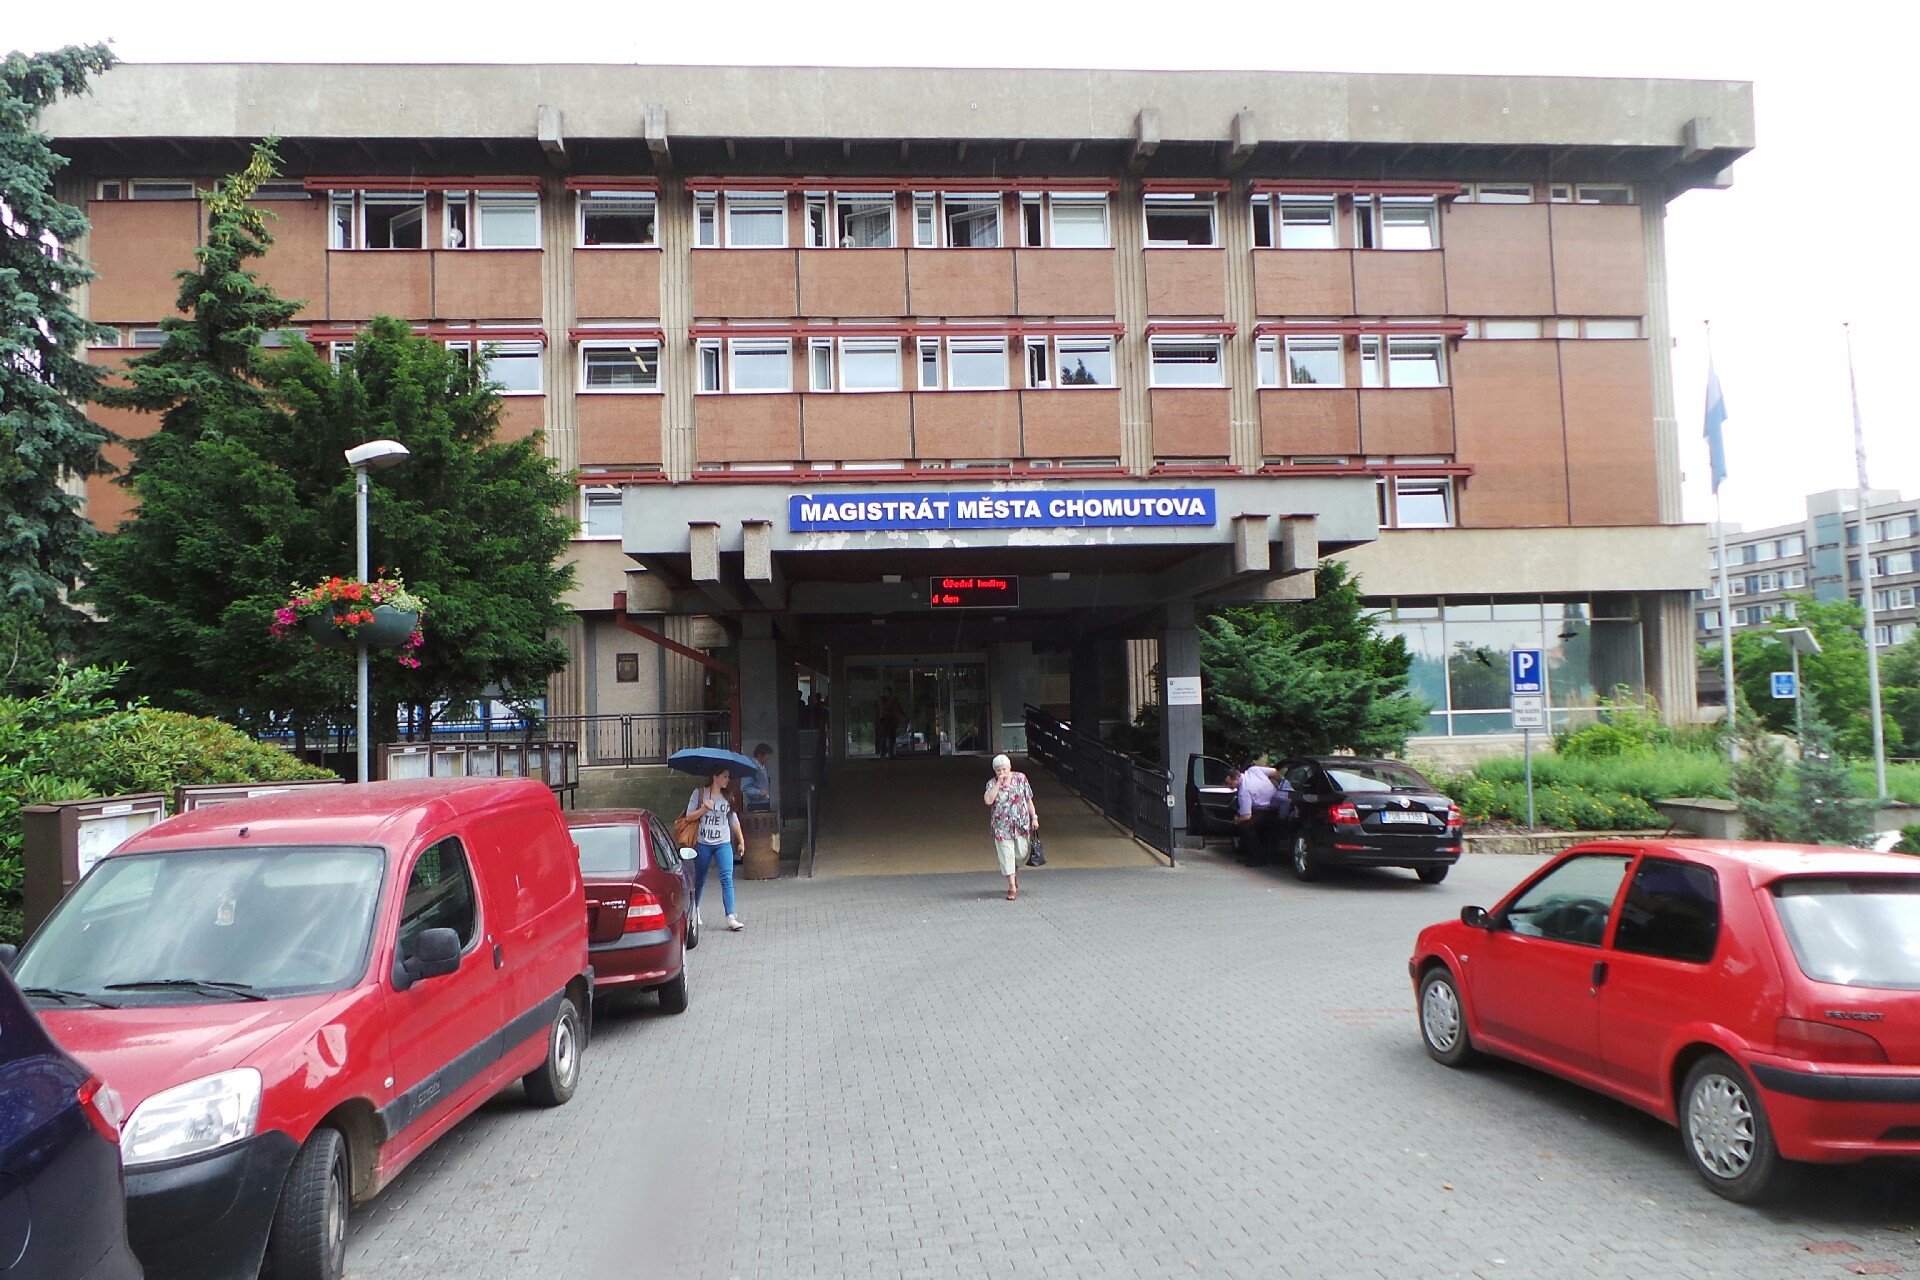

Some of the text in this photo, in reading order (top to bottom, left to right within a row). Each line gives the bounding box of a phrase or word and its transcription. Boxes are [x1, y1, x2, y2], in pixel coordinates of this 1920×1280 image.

[801, 496, 1206, 522] MAGISTRÁT MĚSTA CHOMUTOVA
[977, 579, 1006, 589] hodiny
[1518, 653, 1533, 678] P
[705, 815, 720, 825] THE
[700, 828, 720, 838] WILD
[1825, 1010, 1884, 1020] PEUGEOT
